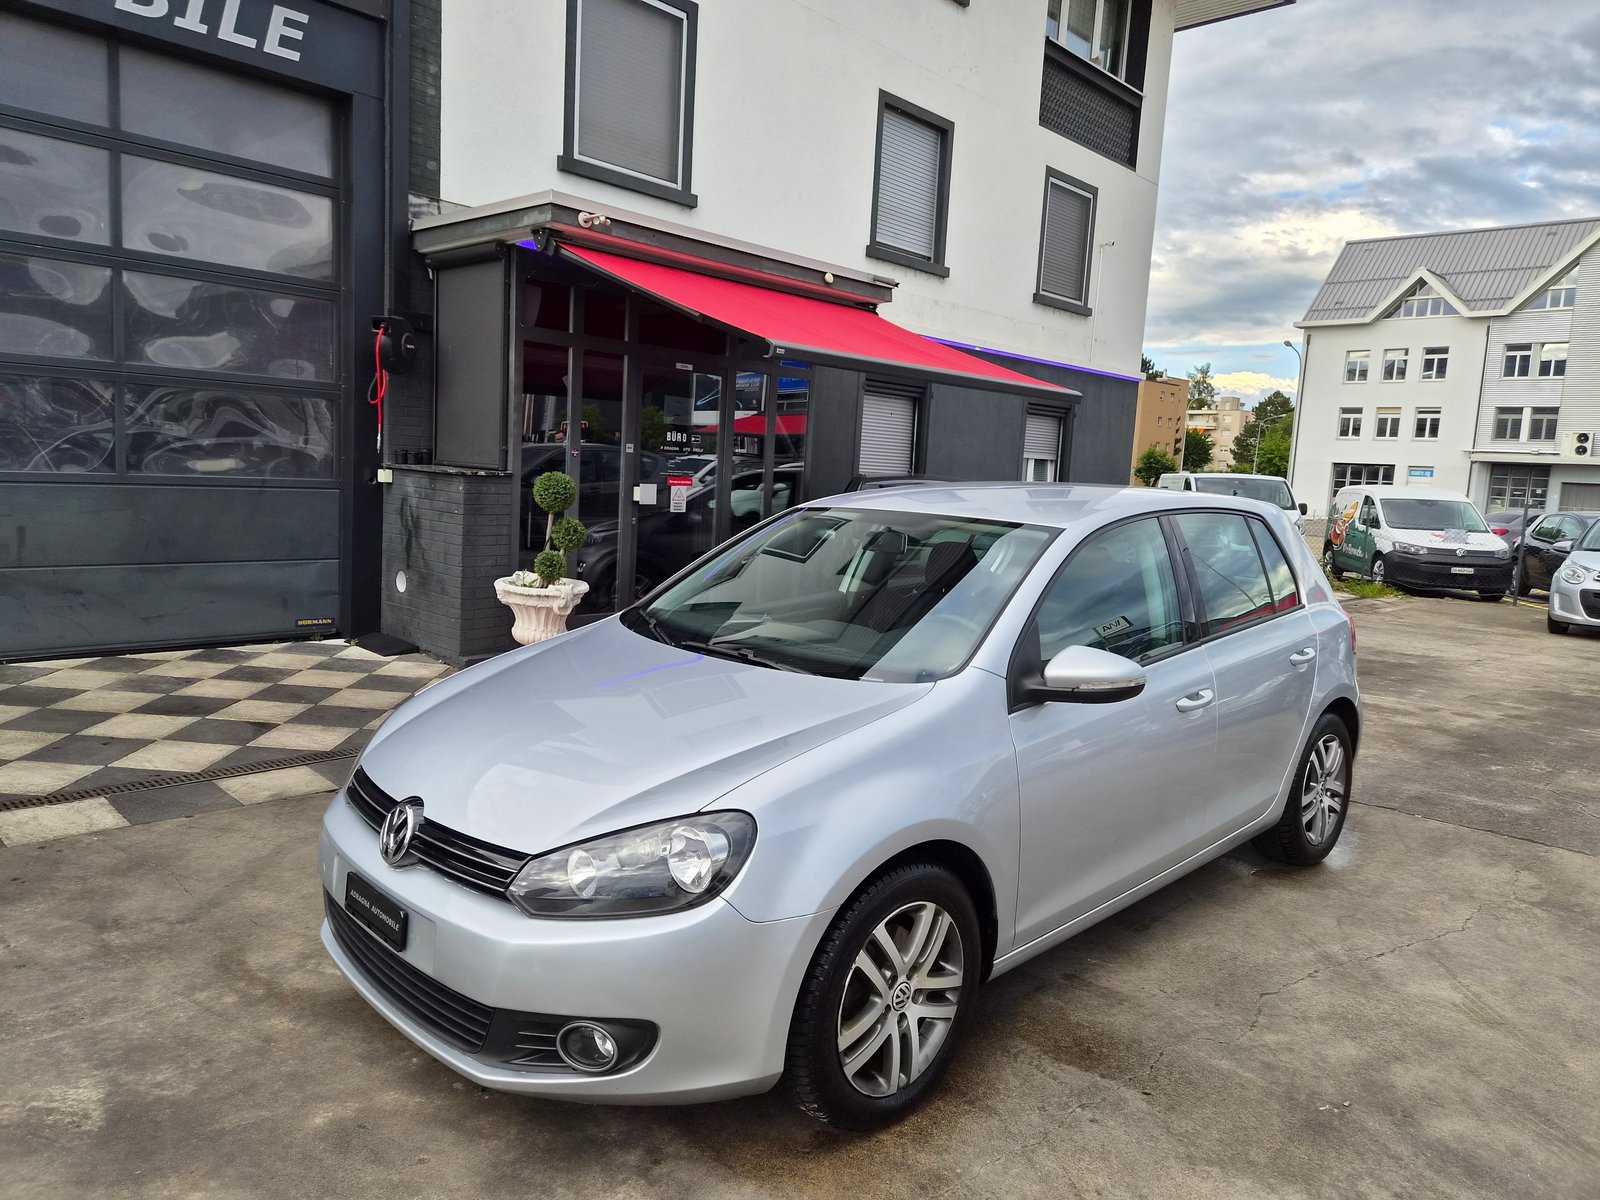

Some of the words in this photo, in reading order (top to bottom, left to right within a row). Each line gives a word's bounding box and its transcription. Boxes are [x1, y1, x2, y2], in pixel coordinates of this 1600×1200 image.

[114, 0, 310, 62] ILE
[350, 889, 370, 909] ADRAGNA
[371, 905, 400, 932] AUTOMOBILE
